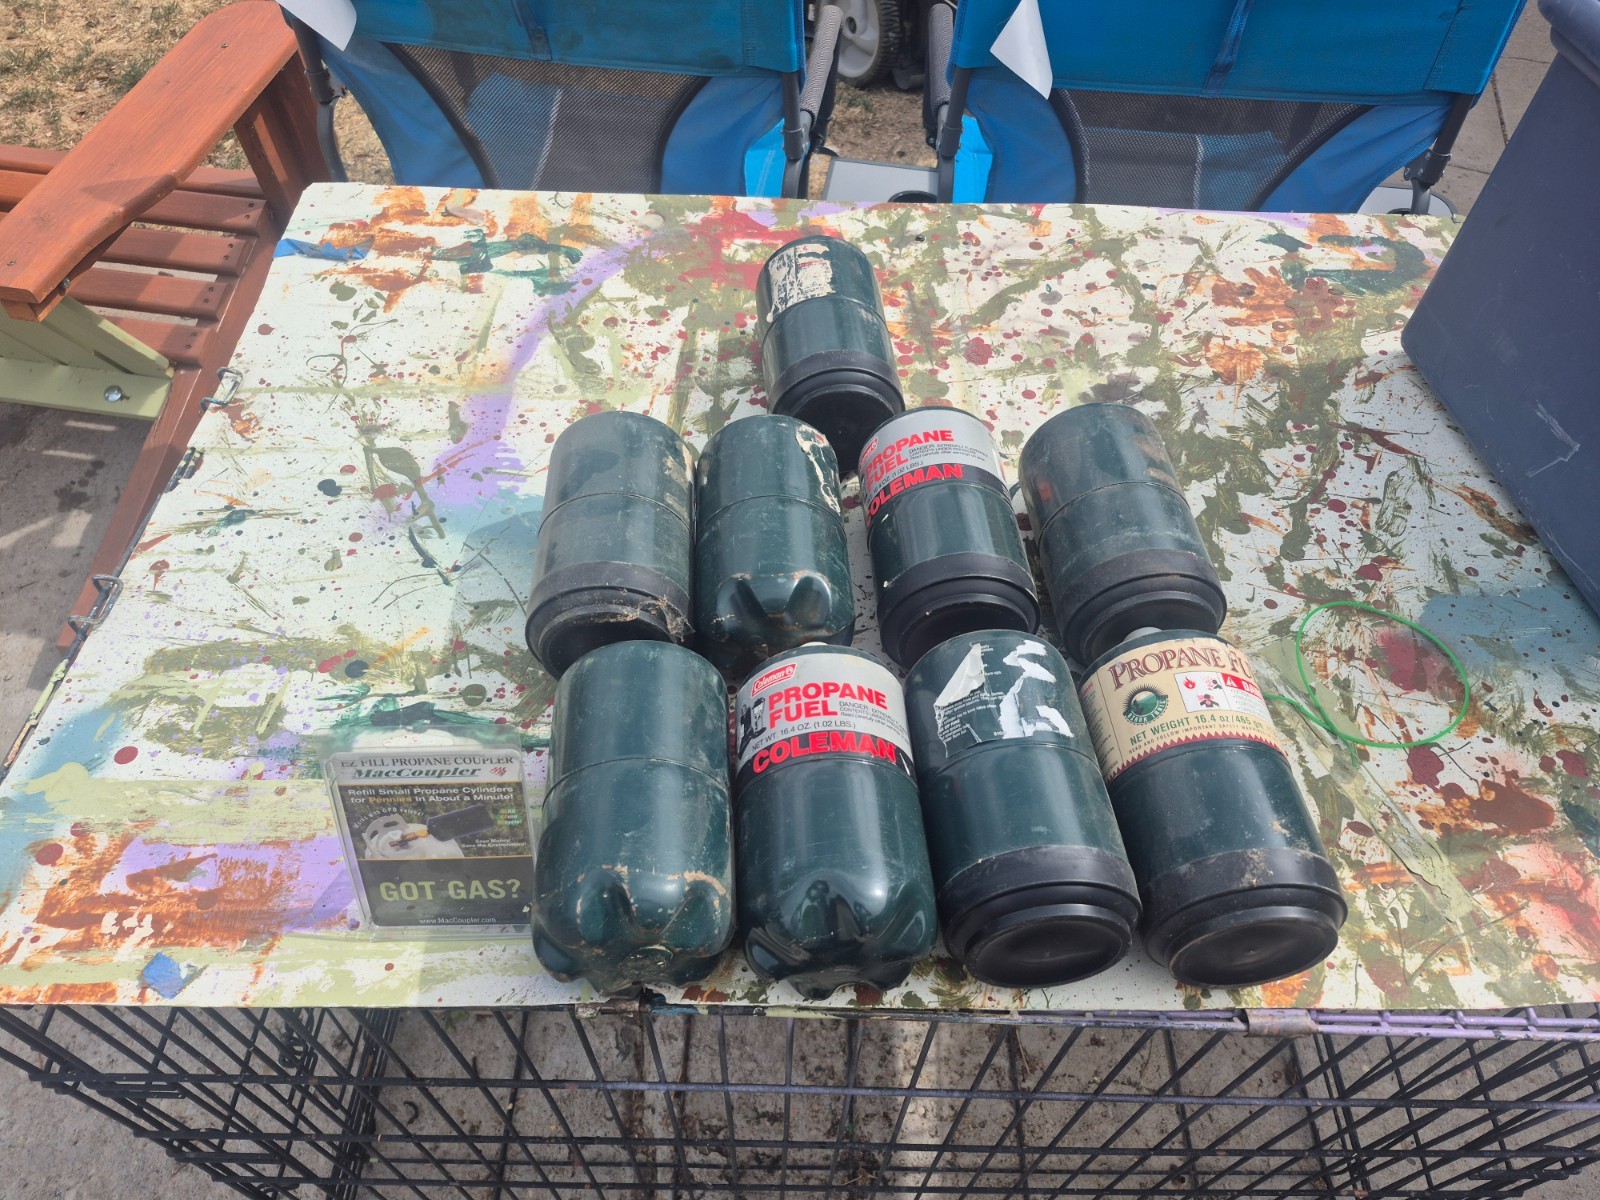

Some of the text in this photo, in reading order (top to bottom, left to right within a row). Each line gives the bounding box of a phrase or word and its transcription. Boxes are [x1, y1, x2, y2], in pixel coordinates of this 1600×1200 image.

[865, 429, 955, 477] PROPANE
[867, 454, 909, 493] FUEL
[865, 463, 965, 529] COLEMAN
[1107, 646, 1226, 691] PROPANE
[768, 682, 888, 710] PROPANE
[769, 700, 838, 729] FUEL
[780, 727, 796, 736] 16.4
[813, 720, 832, 729] (1.02
[834, 720, 856, 729] LBS.)
[1130, 730, 1147, 746] NET
[1150, 717, 1190, 736] WEIGHT
[1195, 714, 1216, 724] 16.4
[1236, 716, 1252, 725] 465
[1144, 738, 1154, 746] AND
[1156, 730, 1180, 740] FOLLOW
[1182, 724, 1216, 733] IMPORTANT
[361, 759, 390, 767] FILL
[392, 757, 452, 766] PROPANE
[454, 756, 514, 765] COUPLER
[753, 731, 896, 774] COLEMAN
[352, 767, 482, 778] MacCoupler
[368, 796, 413, 804] Pennies
[428, 794, 460, 802] About
[474, 793, 514, 801] Minute!
[414, 787, 459, 796] Propane
[462, 786, 514, 794] Cylinders
[380, 878, 520, 901] GOT GAS?
